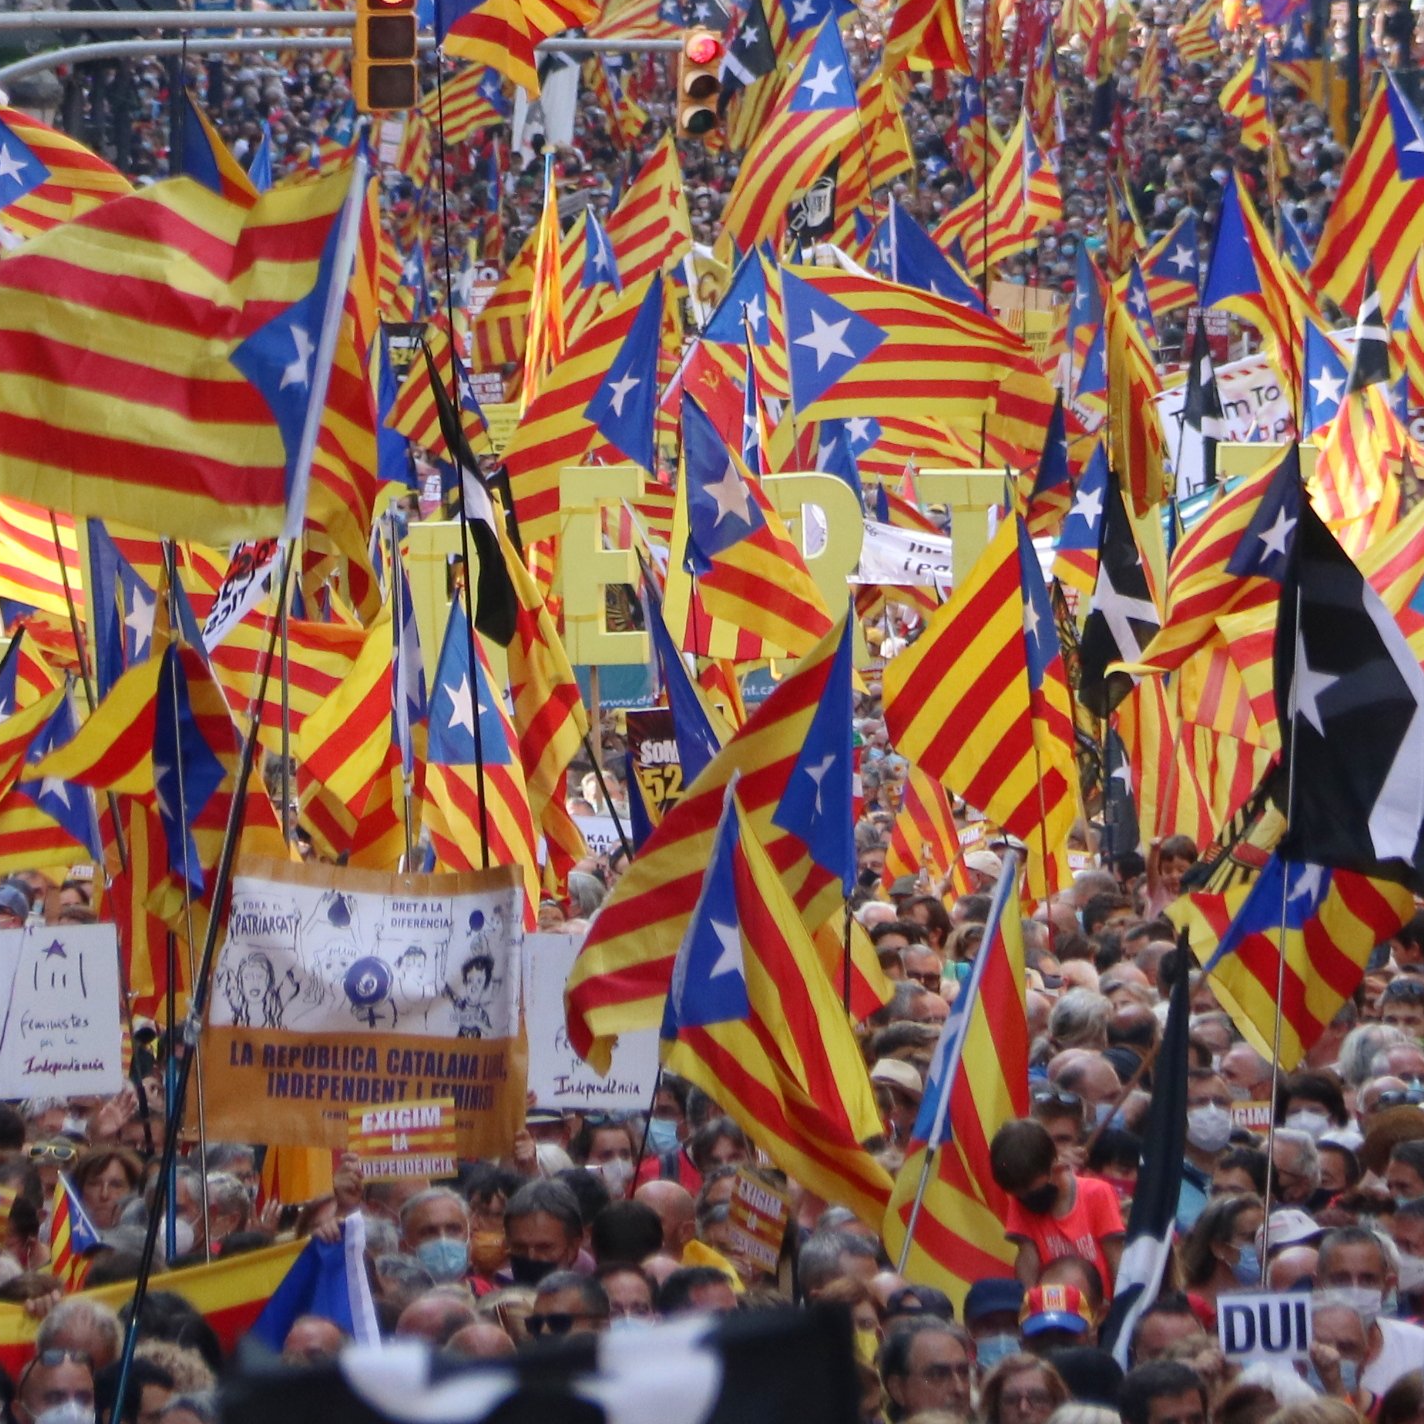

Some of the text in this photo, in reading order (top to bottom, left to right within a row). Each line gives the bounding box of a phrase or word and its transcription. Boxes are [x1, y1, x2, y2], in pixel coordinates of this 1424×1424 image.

[392, 901, 443, 913] DRET A LA
[230, 1041, 254, 1067] LA
[262, 1043, 377, 1074] REPÚBLICA
[387, 1049, 478, 1080] CATALANA
[267, 1072, 408, 1105] INDEPENDENT
[361, 1106, 442, 1133] EXIGIM
[392, 1133, 408, 1151] LA
[361, 1155, 454, 1177] DEPENDÈNCIA
[1223, 1301, 1308, 1353] DUI
